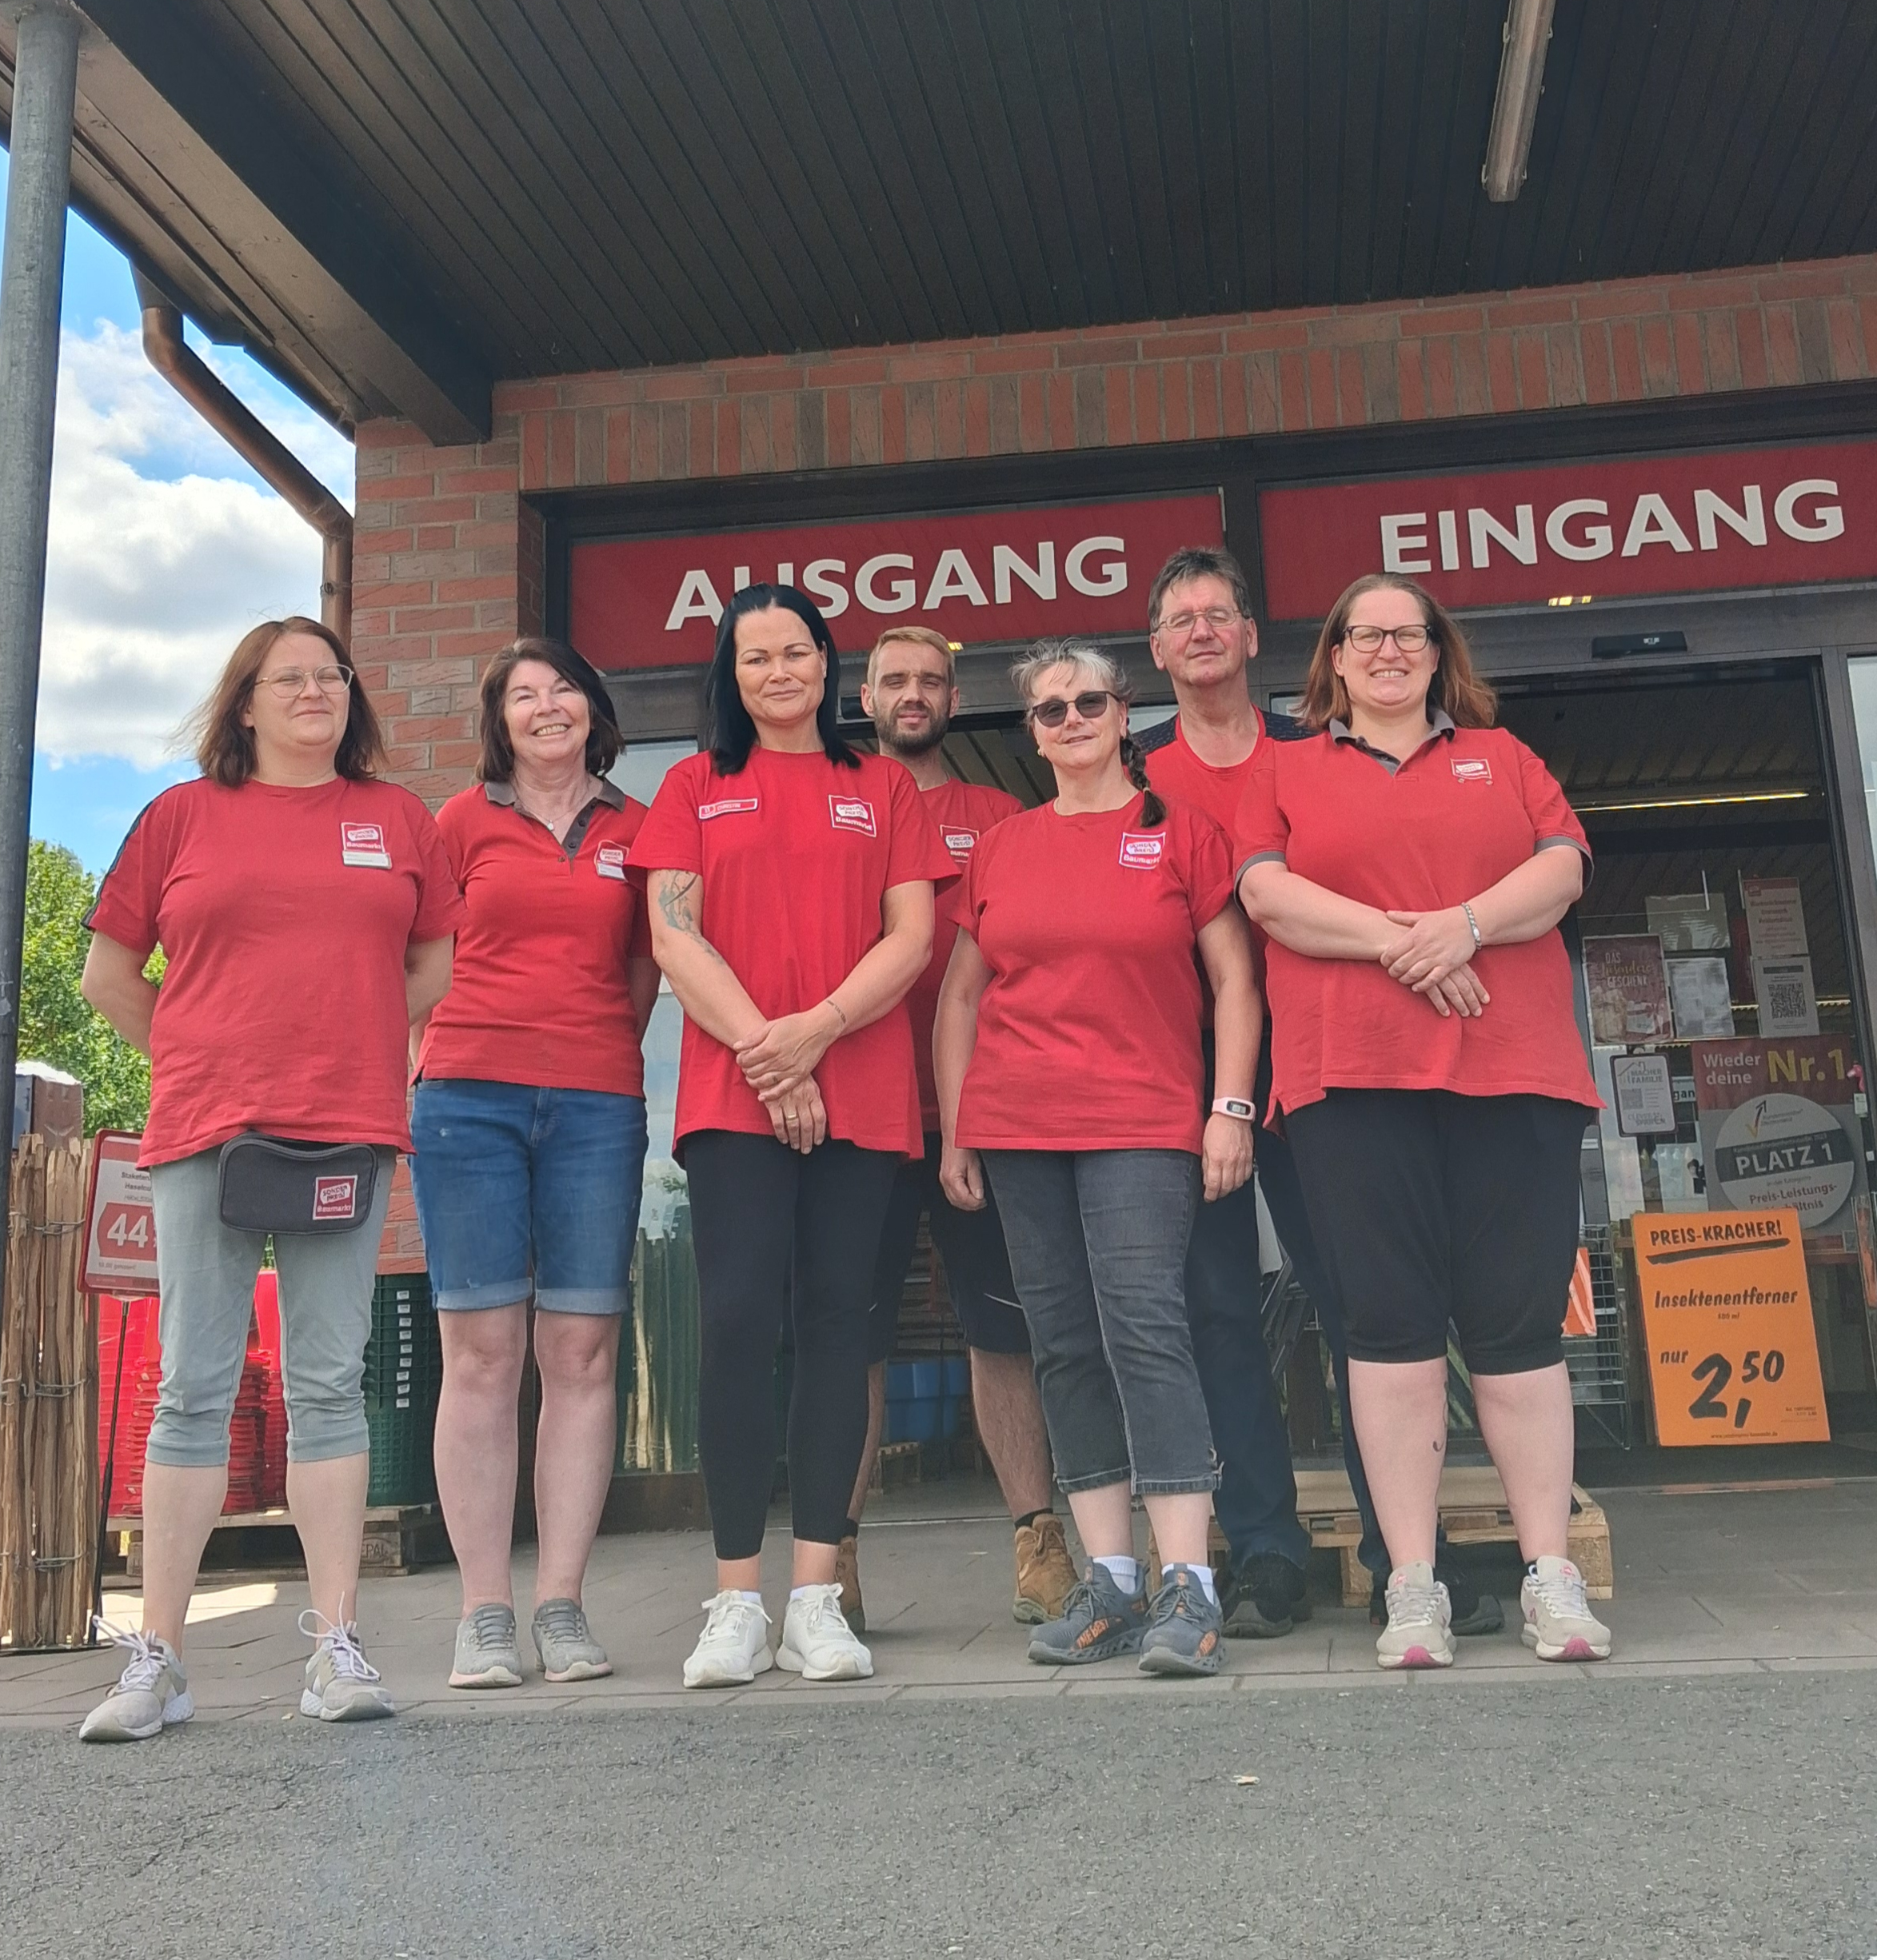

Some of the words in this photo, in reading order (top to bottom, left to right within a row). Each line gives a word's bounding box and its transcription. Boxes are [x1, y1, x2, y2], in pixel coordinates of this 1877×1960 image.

[1380, 478, 1844, 573] EINGANG
[1703, 1052, 1760, 1068] Wieder
[1706, 1071, 1751, 1085] deine
[1735, 1145, 1815, 1176] PLATZ
[1822, 1143, 1832, 1160] 1
[1750, 1184, 1837, 1204] Preis-Leistungs-
[1650, 1220, 1782, 1246] PREIS-KRACHER!
[1655, 1287, 1798, 1308] Insektenentferner
[1660, 1350, 1688, 1363] nur
